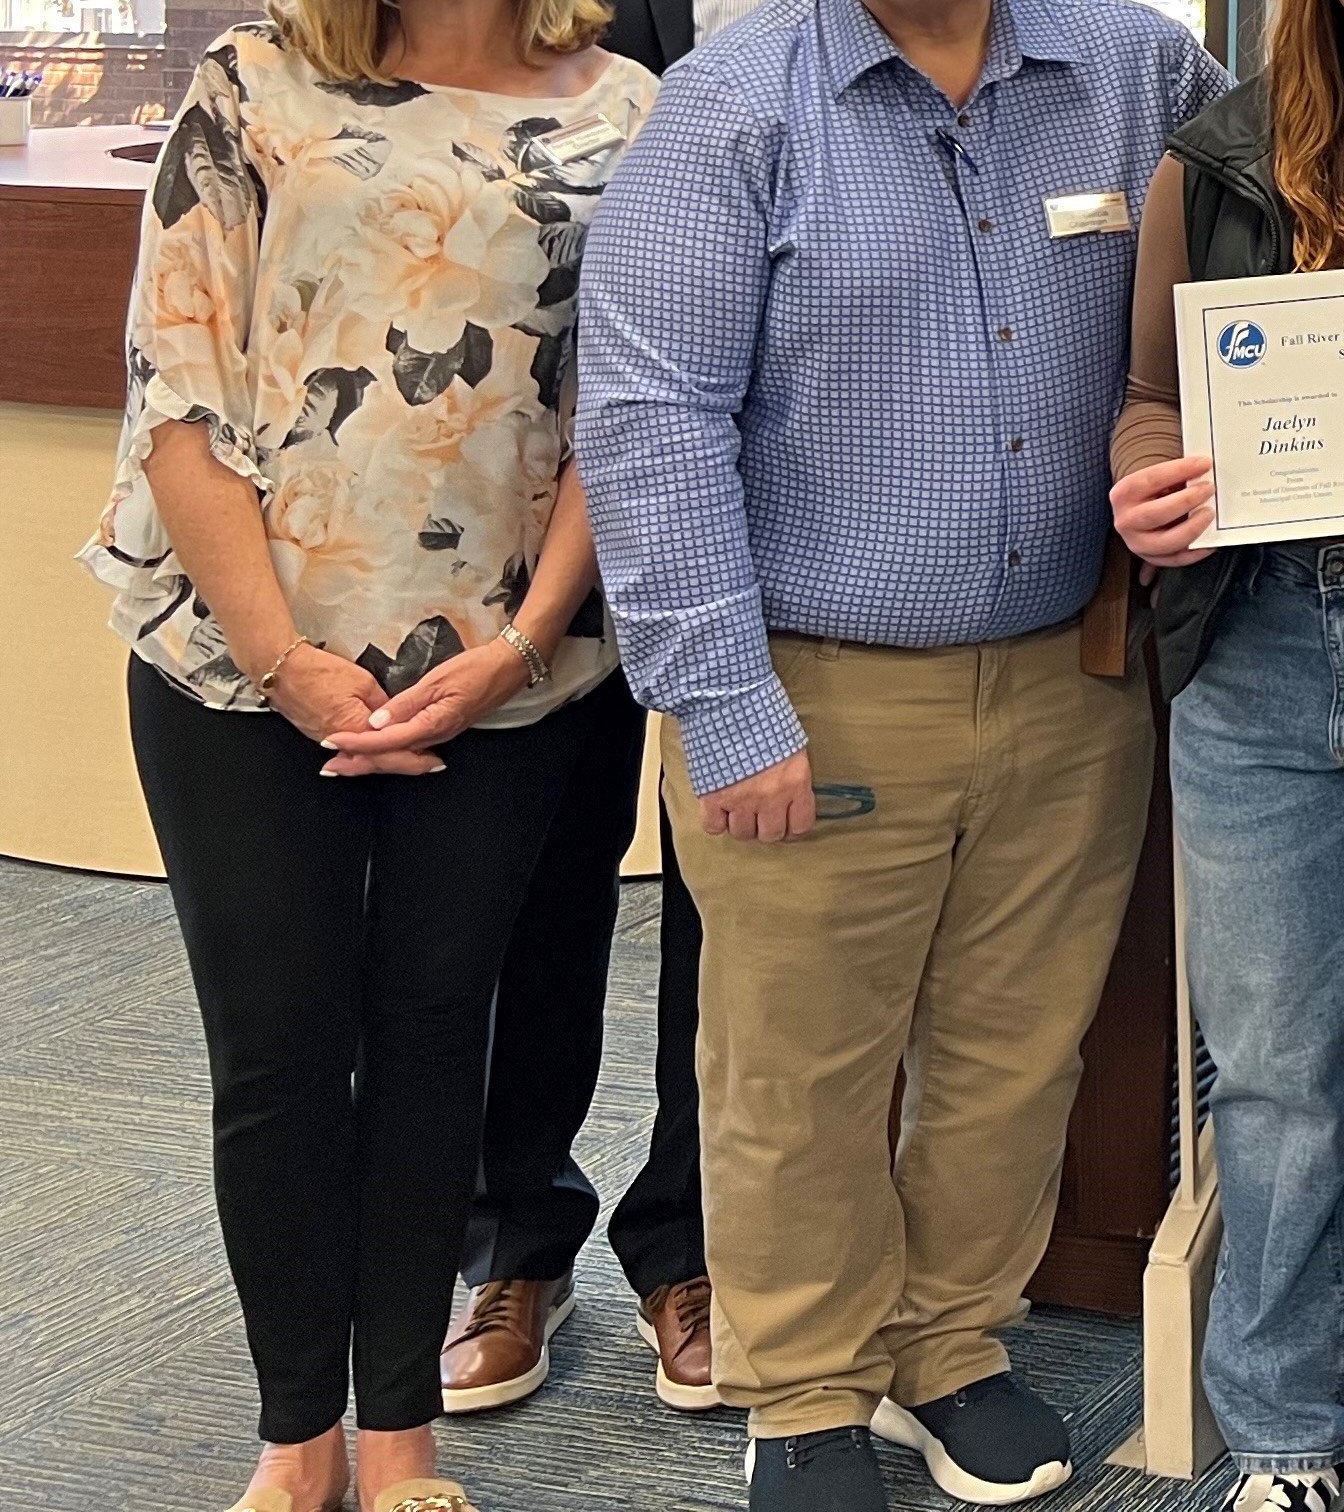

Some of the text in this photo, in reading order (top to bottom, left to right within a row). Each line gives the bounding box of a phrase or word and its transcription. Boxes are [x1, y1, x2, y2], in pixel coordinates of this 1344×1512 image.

[1281, 335, 1304, 347] Fall
[1308, 332, 1339, 344] River
[1262, 414, 1316, 433] Jaelyn
[1258, 436, 1325, 456] Dinkins
